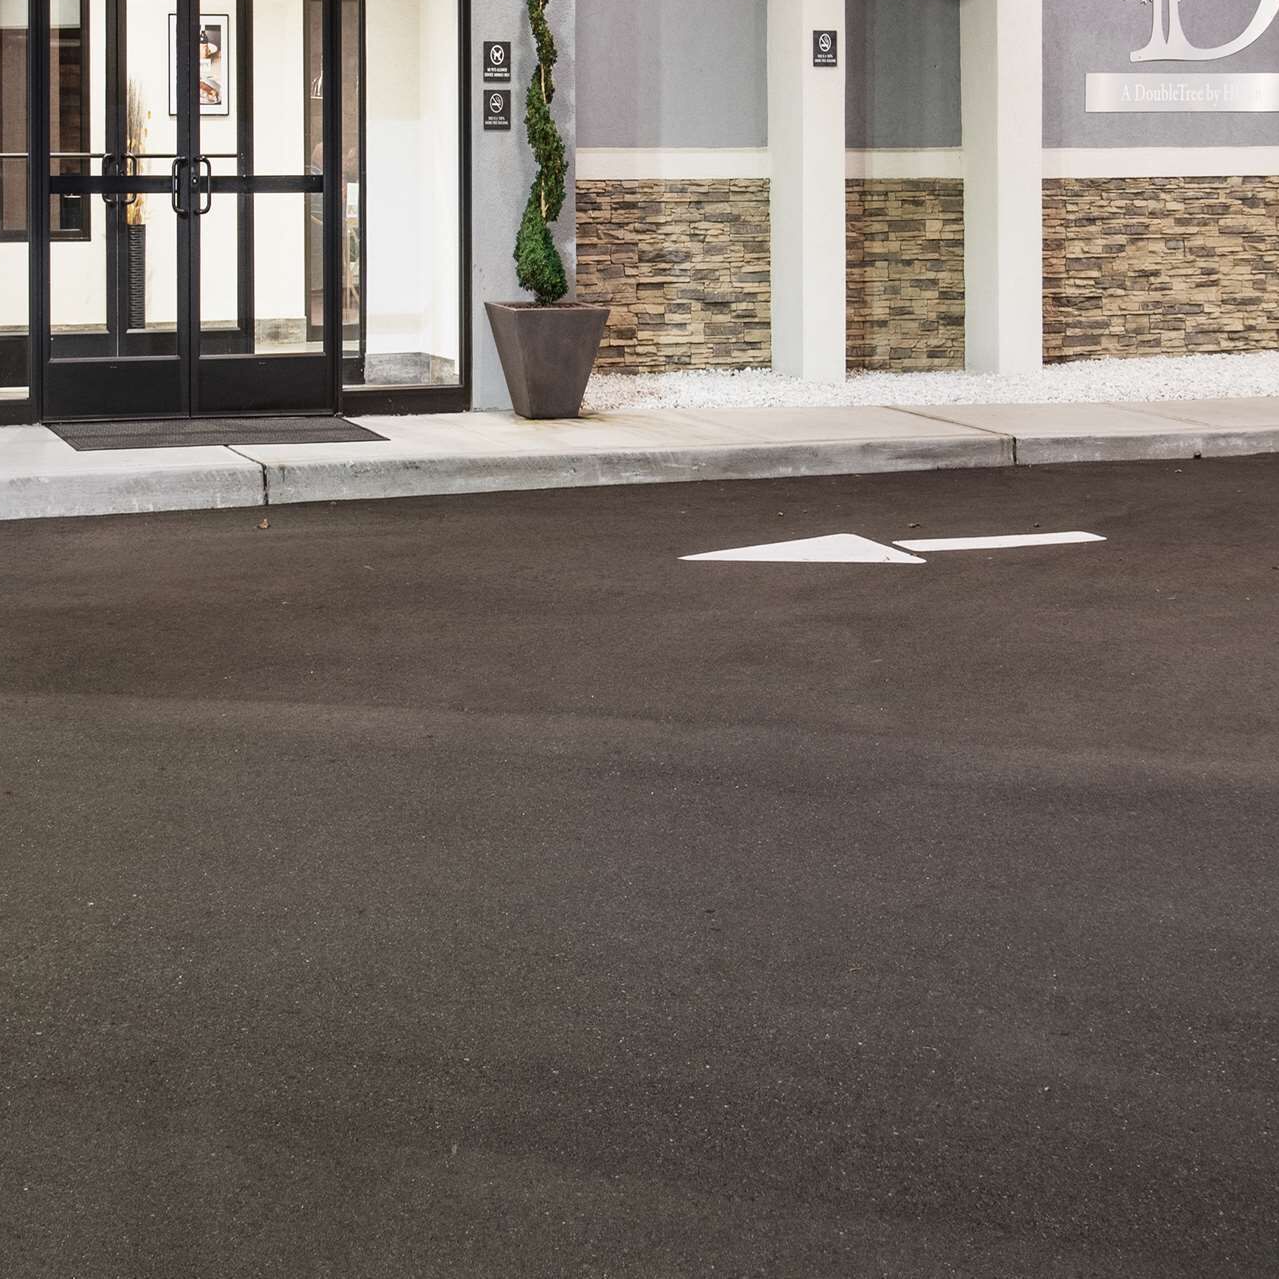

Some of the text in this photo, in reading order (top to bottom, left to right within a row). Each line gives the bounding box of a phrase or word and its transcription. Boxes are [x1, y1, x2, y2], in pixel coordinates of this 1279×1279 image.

[1120, 84, 1133, 102] A
[1135, 84, 1205, 103] DoubleTree
[1207, 84, 1222, 106] by
